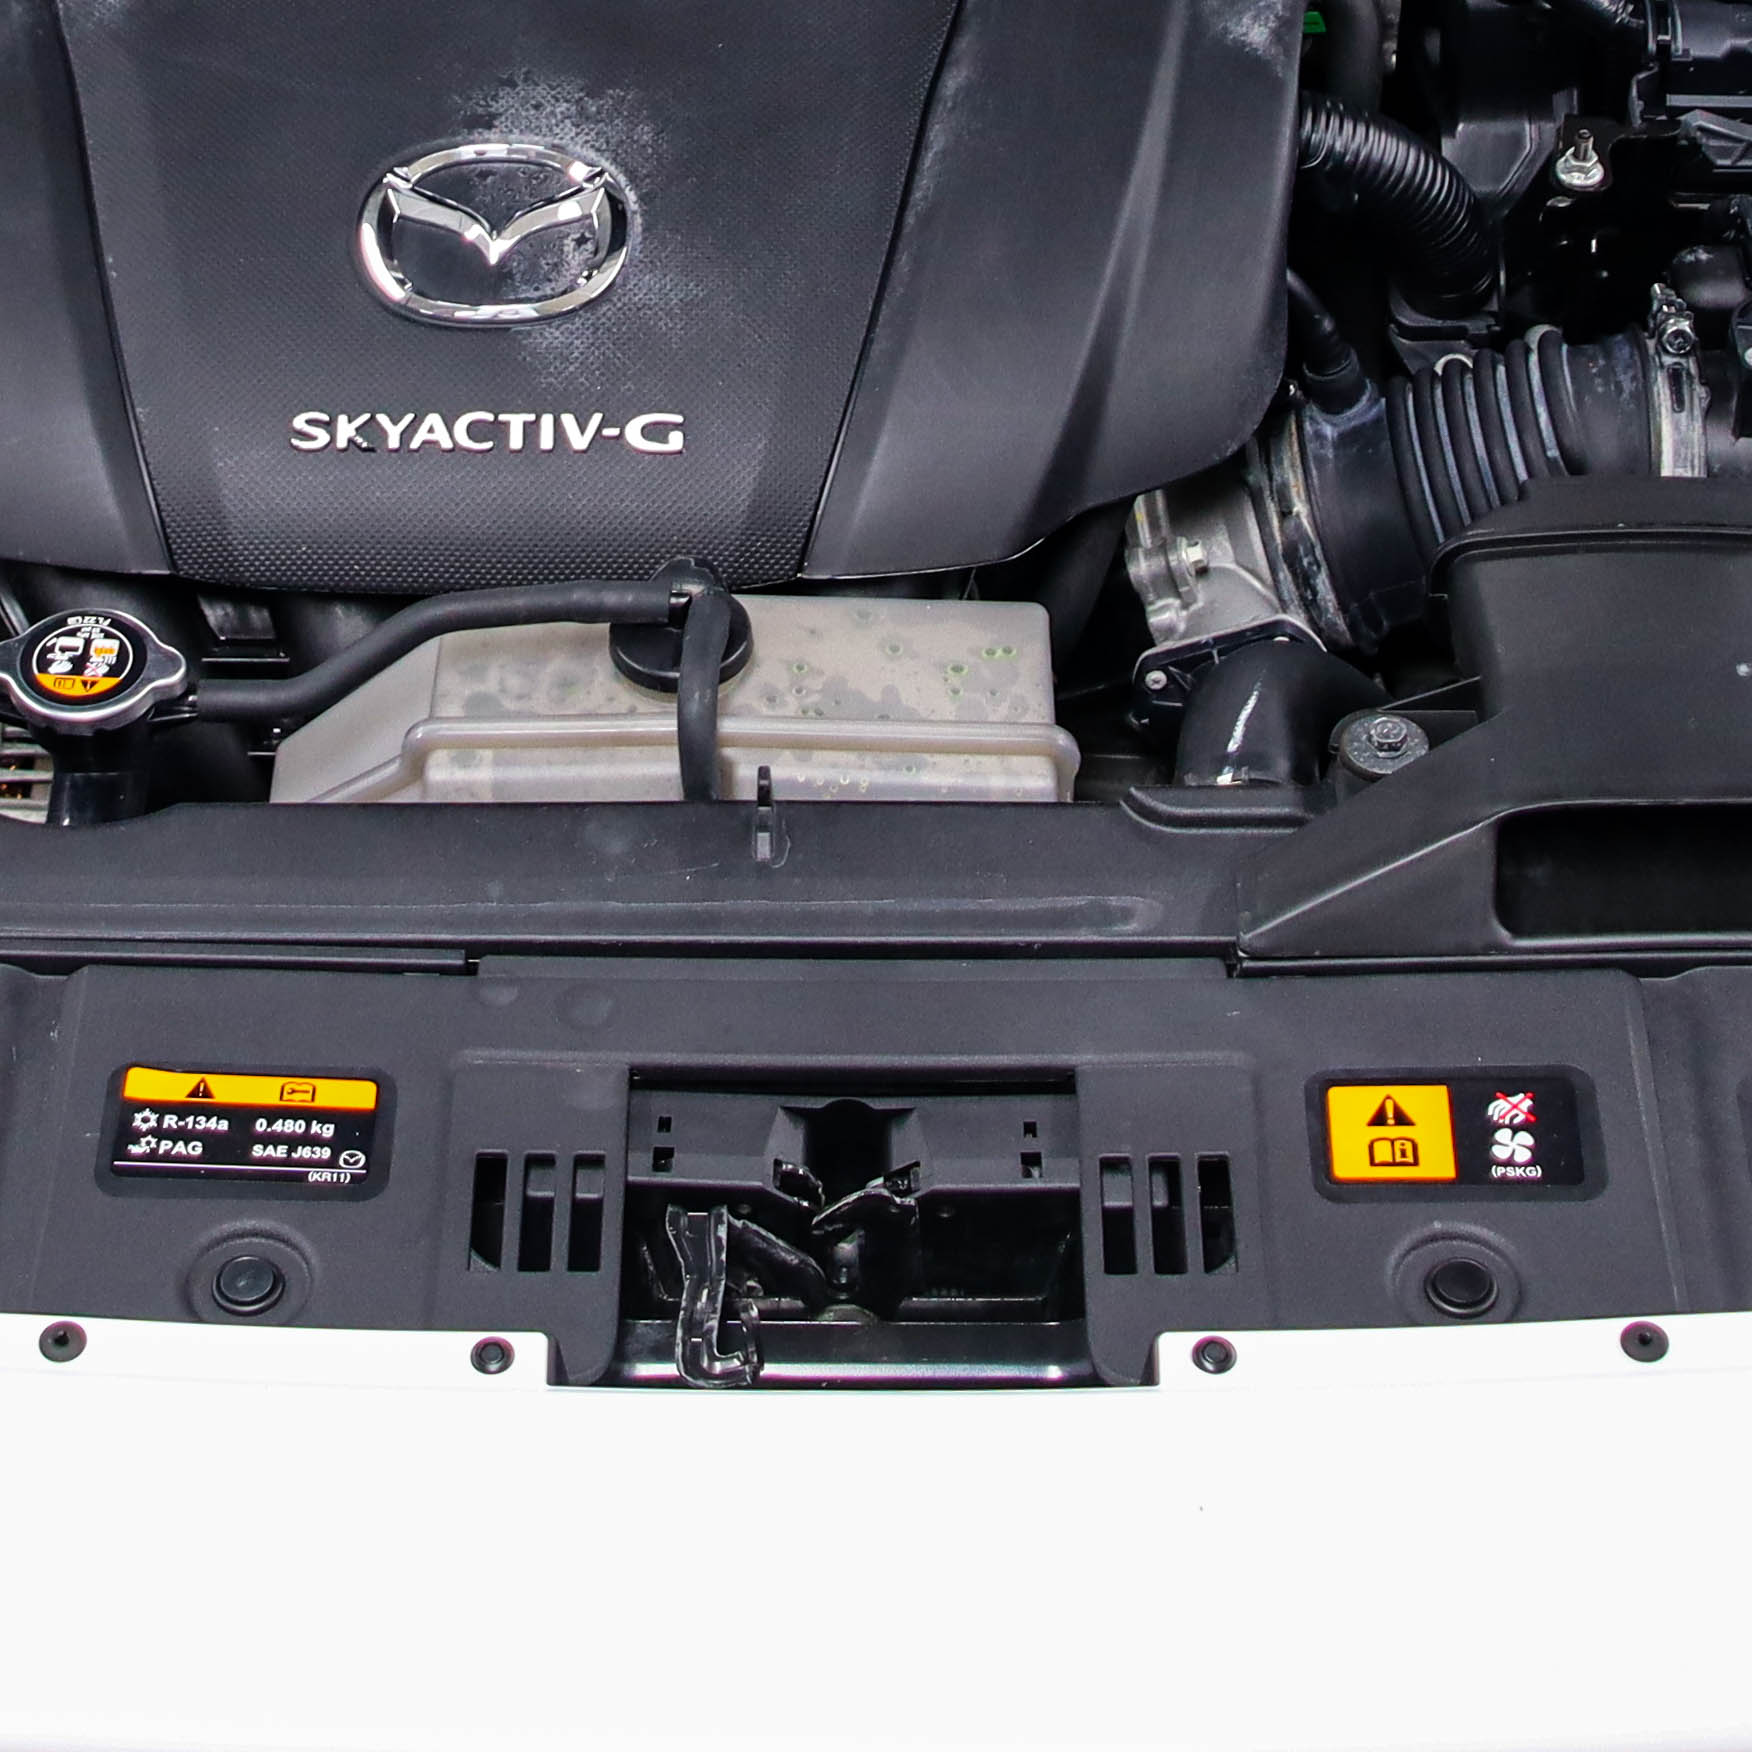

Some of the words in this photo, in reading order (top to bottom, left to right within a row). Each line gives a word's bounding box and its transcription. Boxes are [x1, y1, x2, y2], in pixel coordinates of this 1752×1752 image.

[290, 410, 685, 454] SKYACTIV-G
[161, 1114, 230, 1131] R-134a
[255, 1117, 307, 1133] 0.480
[310, 1118, 336, 1137] kg
[158, 1140, 203, 1155] PAG
[251, 1143, 288, 1157] SAE
[291, 1145, 332, 1159] J639
[307, 1171, 351, 1184] (KR11)
[1490, 1164, 1543, 1178] (PSKG)
